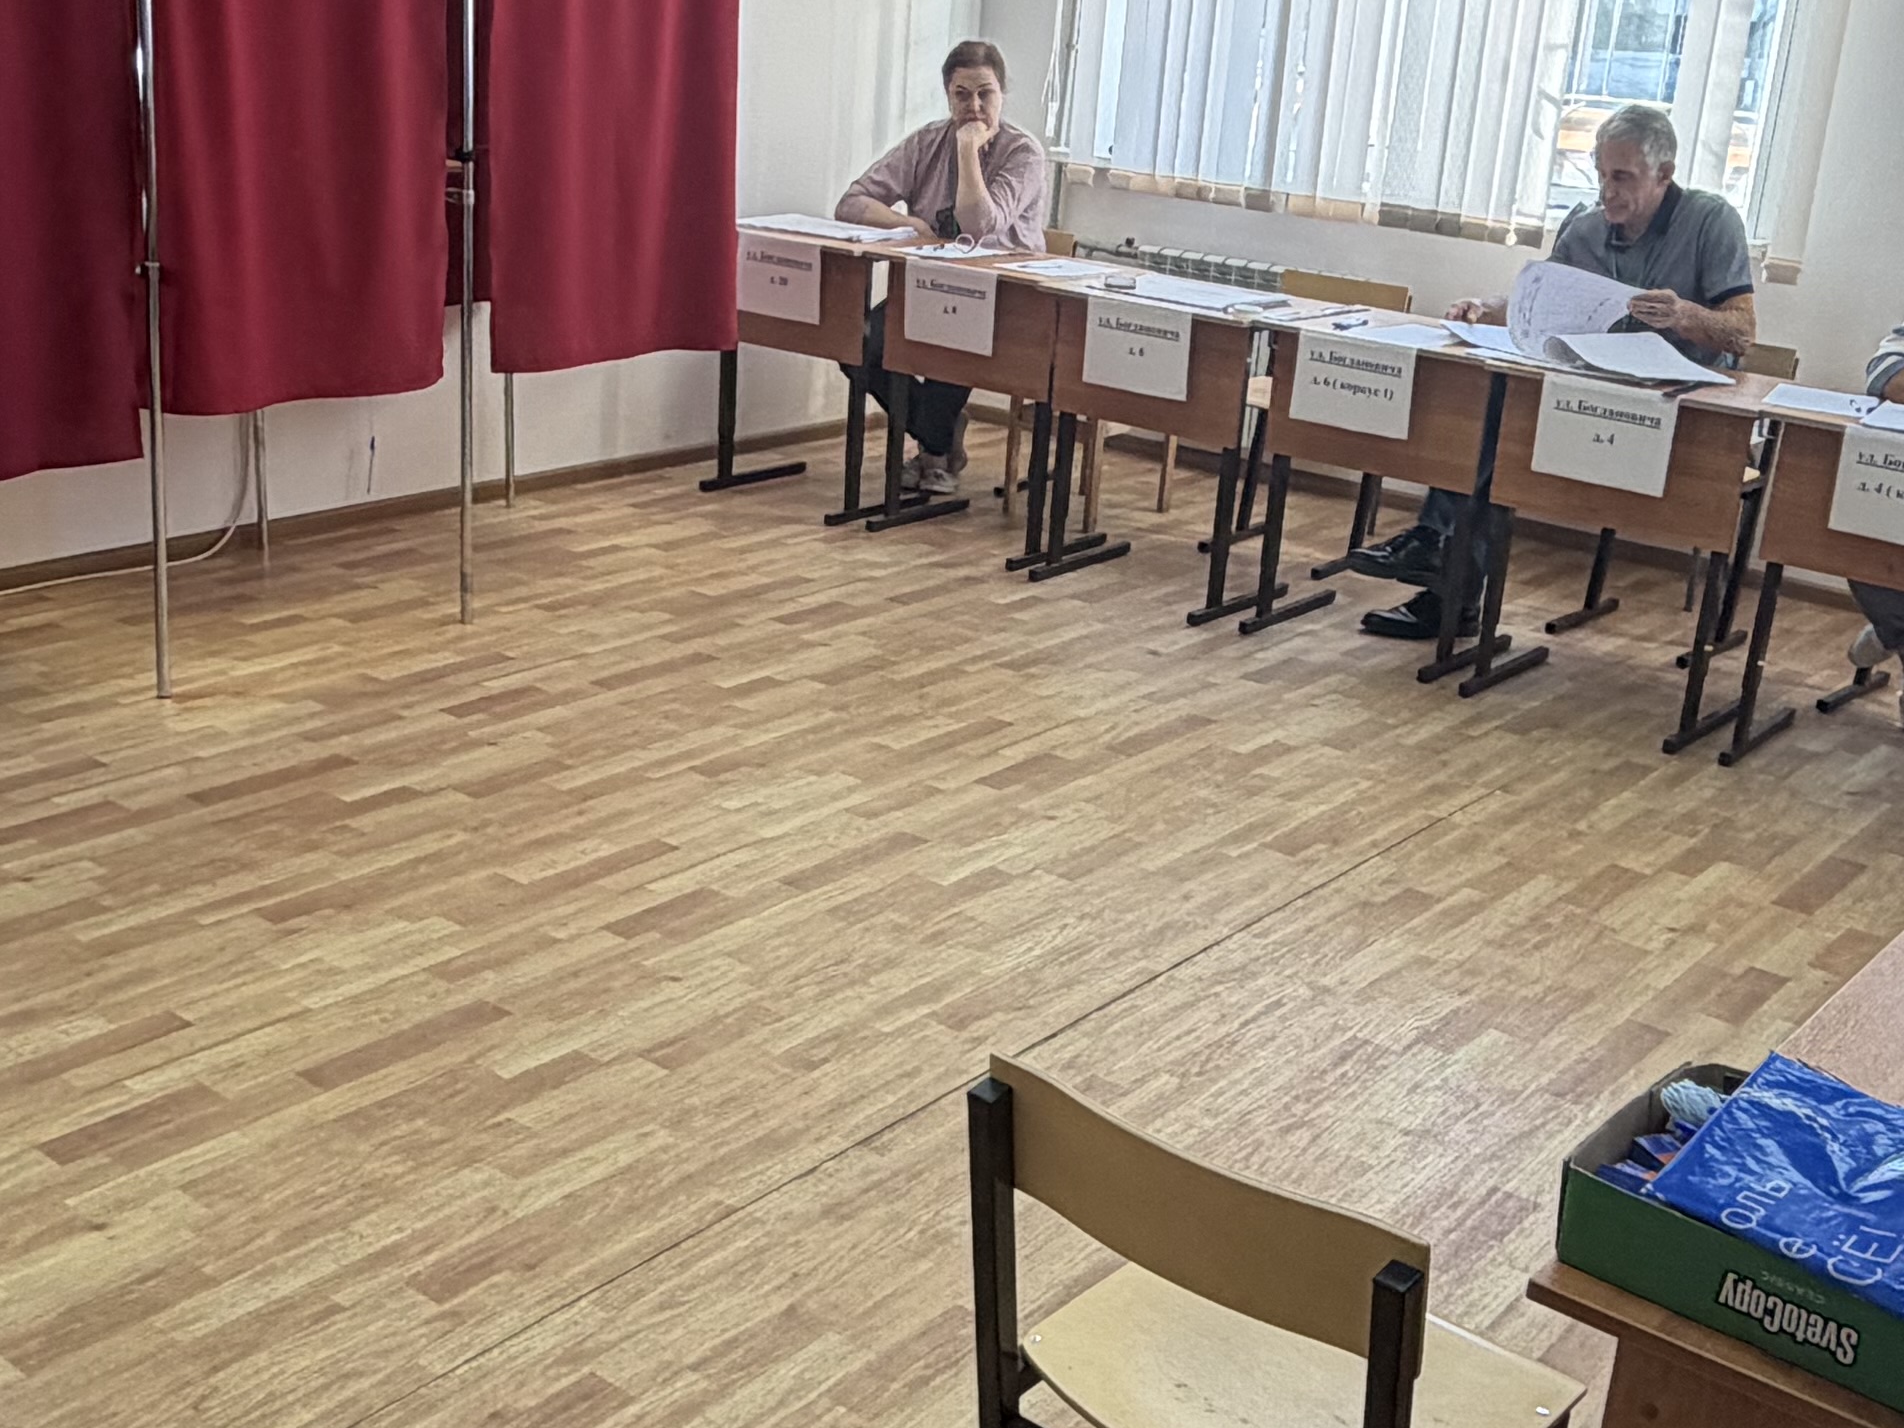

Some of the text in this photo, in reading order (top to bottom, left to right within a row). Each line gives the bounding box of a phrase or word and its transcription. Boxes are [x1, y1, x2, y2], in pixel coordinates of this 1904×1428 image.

[1578, 399, 1663, 428] Богдановича
[1856, 451, 1877, 465] ул.
[1874, 482, 1884, 495] 4
[1717, 1270, 1860, 1366] SvetoCopy
